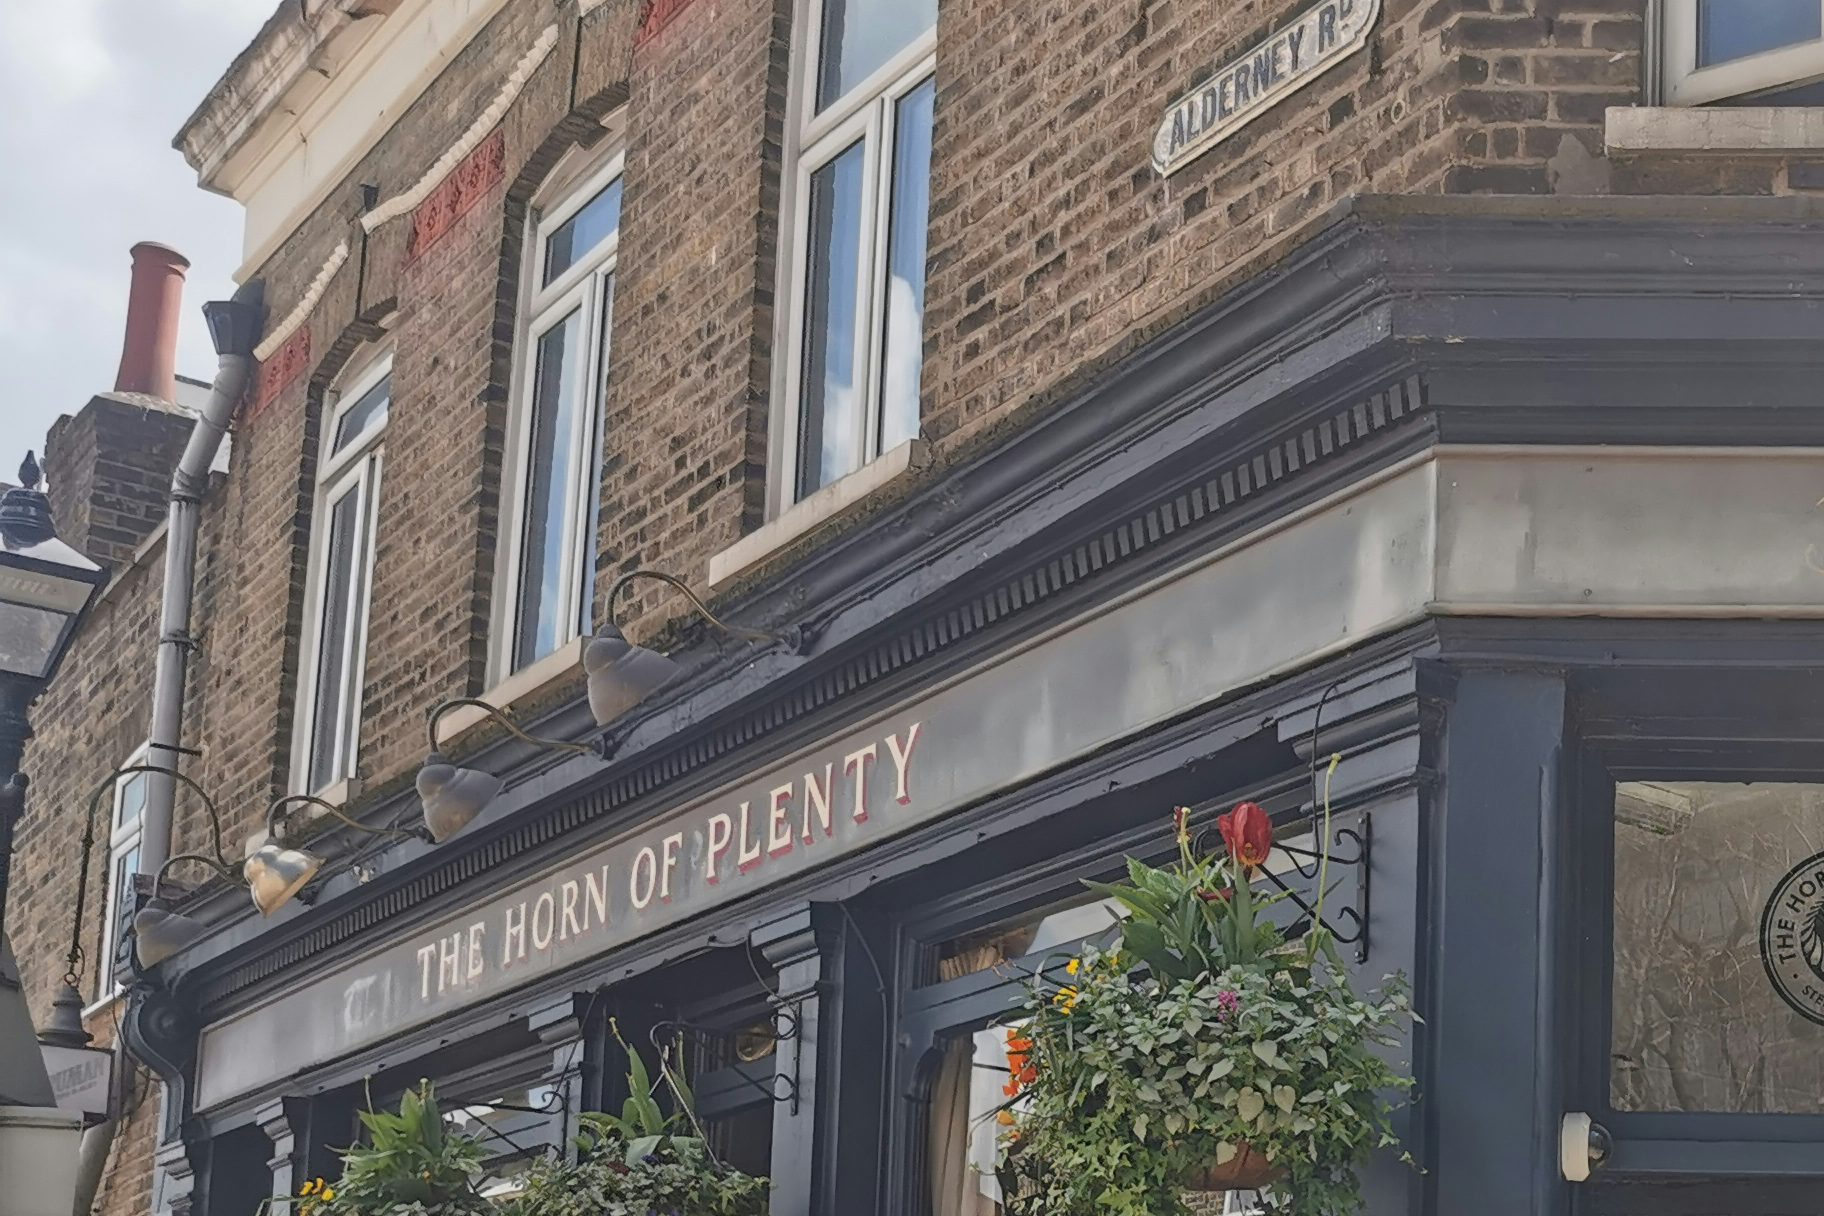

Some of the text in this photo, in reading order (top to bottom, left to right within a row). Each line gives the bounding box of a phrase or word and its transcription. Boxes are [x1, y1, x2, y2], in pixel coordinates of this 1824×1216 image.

[1168, 24, 1306, 155] ALDERNEY
[416, 722, 923, 1001] THE HORN OF PLENTY
[1777, 918, 1796, 965] THE
